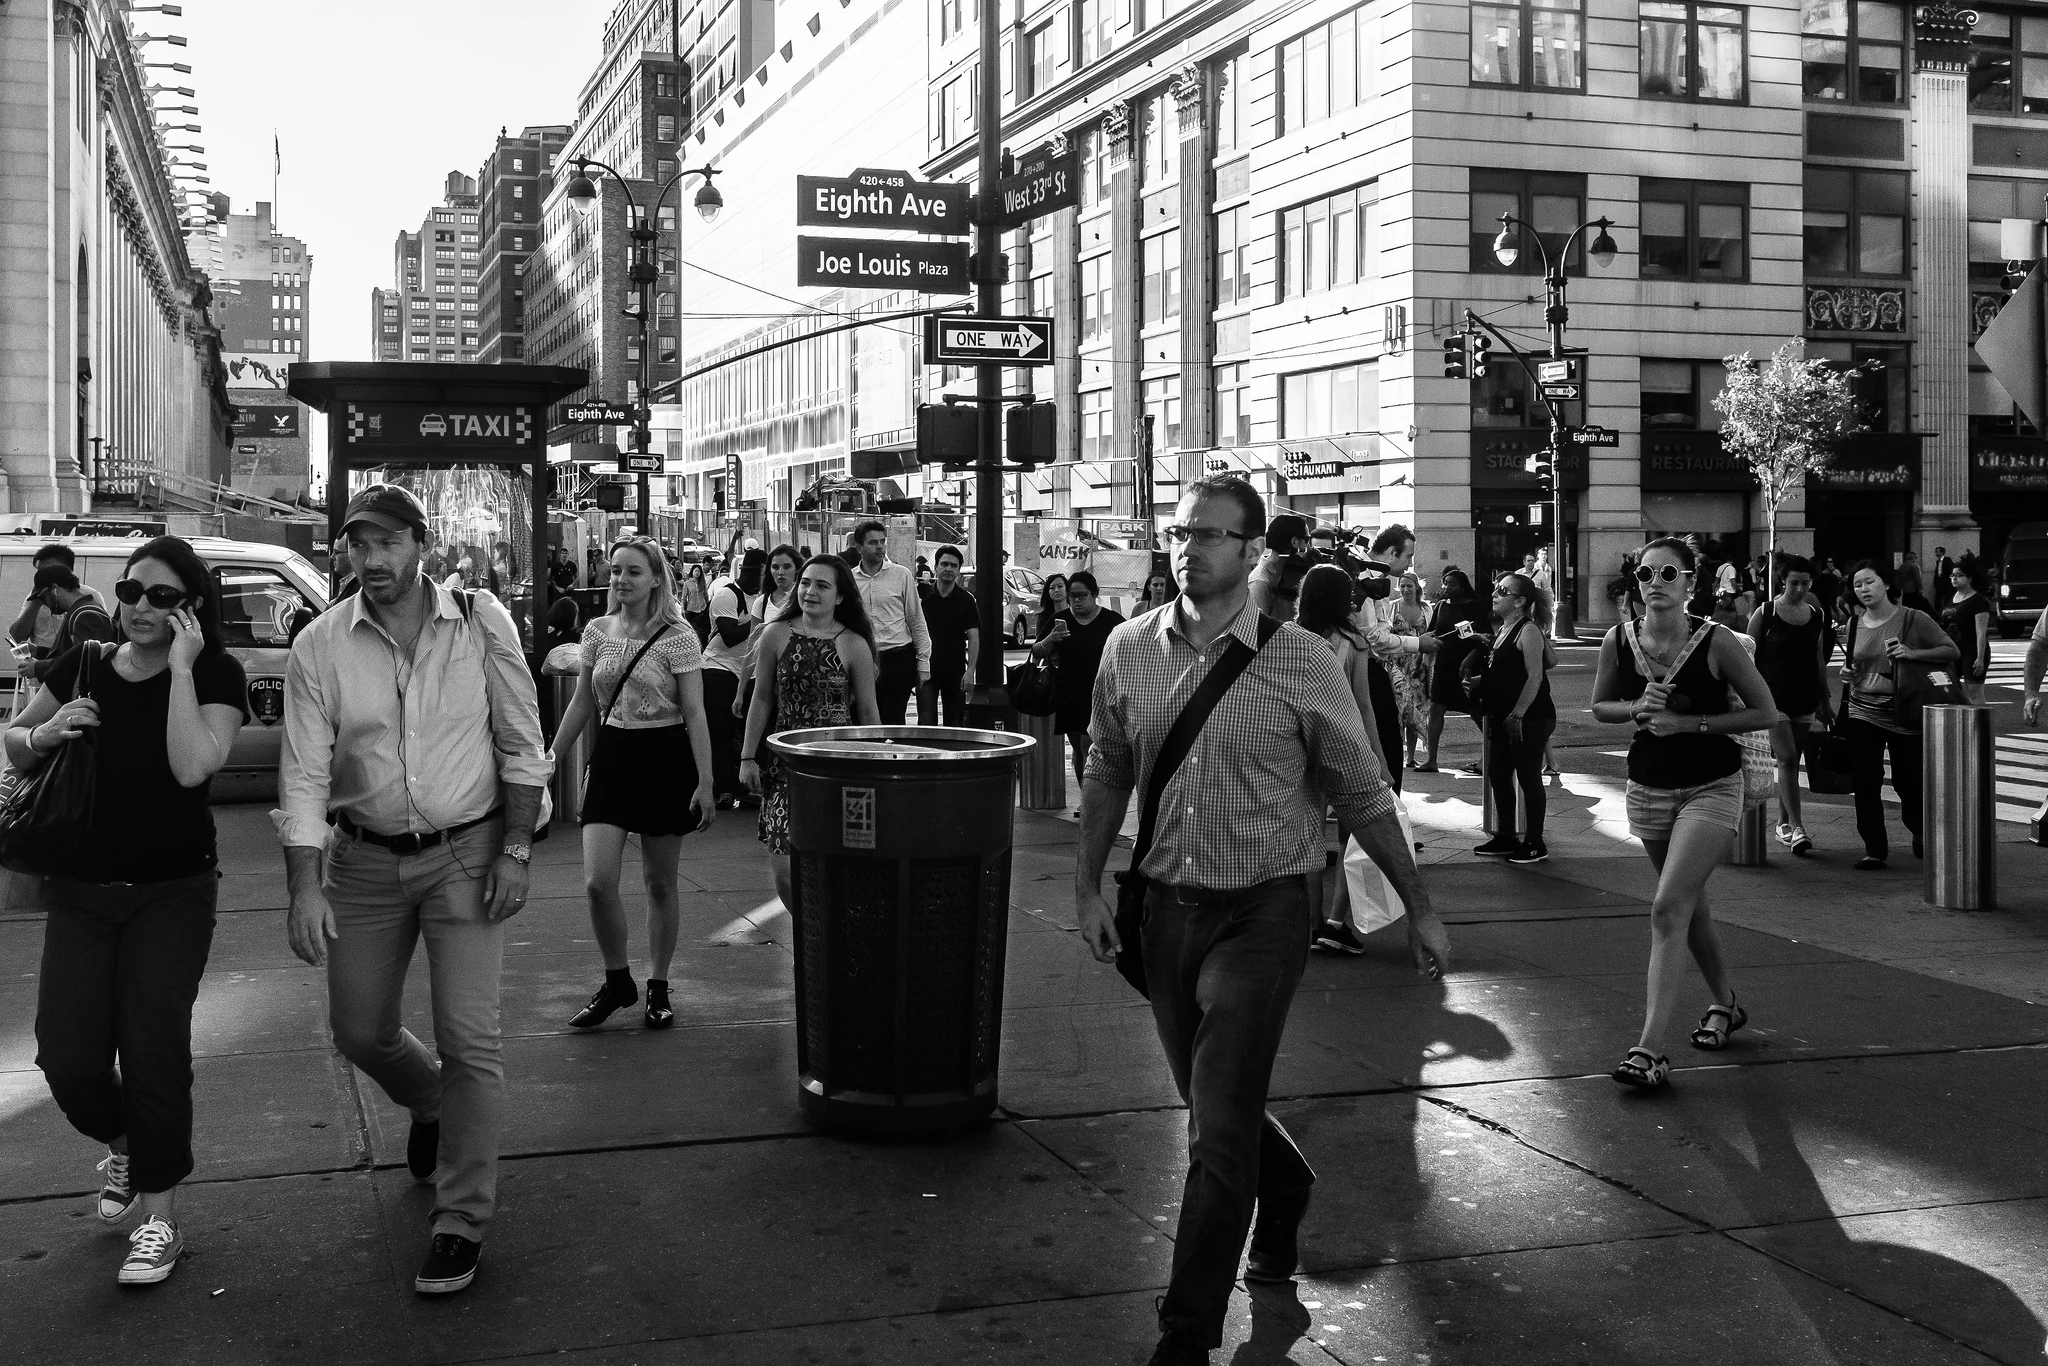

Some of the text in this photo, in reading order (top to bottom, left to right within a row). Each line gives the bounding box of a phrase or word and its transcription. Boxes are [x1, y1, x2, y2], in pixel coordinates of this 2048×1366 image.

[860, 176, 904, 187] 420 458
[1004, 170, 1066, 214] West 33rd St
[816, 188, 947, 218] Eighth Ave
[816, 251, 949, 276] Joe Louis Plaza
[956, 332, 1033, 347] ONE WAY
[568, 408, 625, 421] Eighth Ave
[449, 414, 509, 437] TAXI
[1573, 432, 1614, 444] Eighth Ave
[632, 459, 658, 468] ONE WAY
[1282, 463, 1336, 478] RESTAURANT
[728, 463, 736, 494] PARK
[1100, 522, 1145, 532] PARK
[251, 680, 285, 692] POLIC
